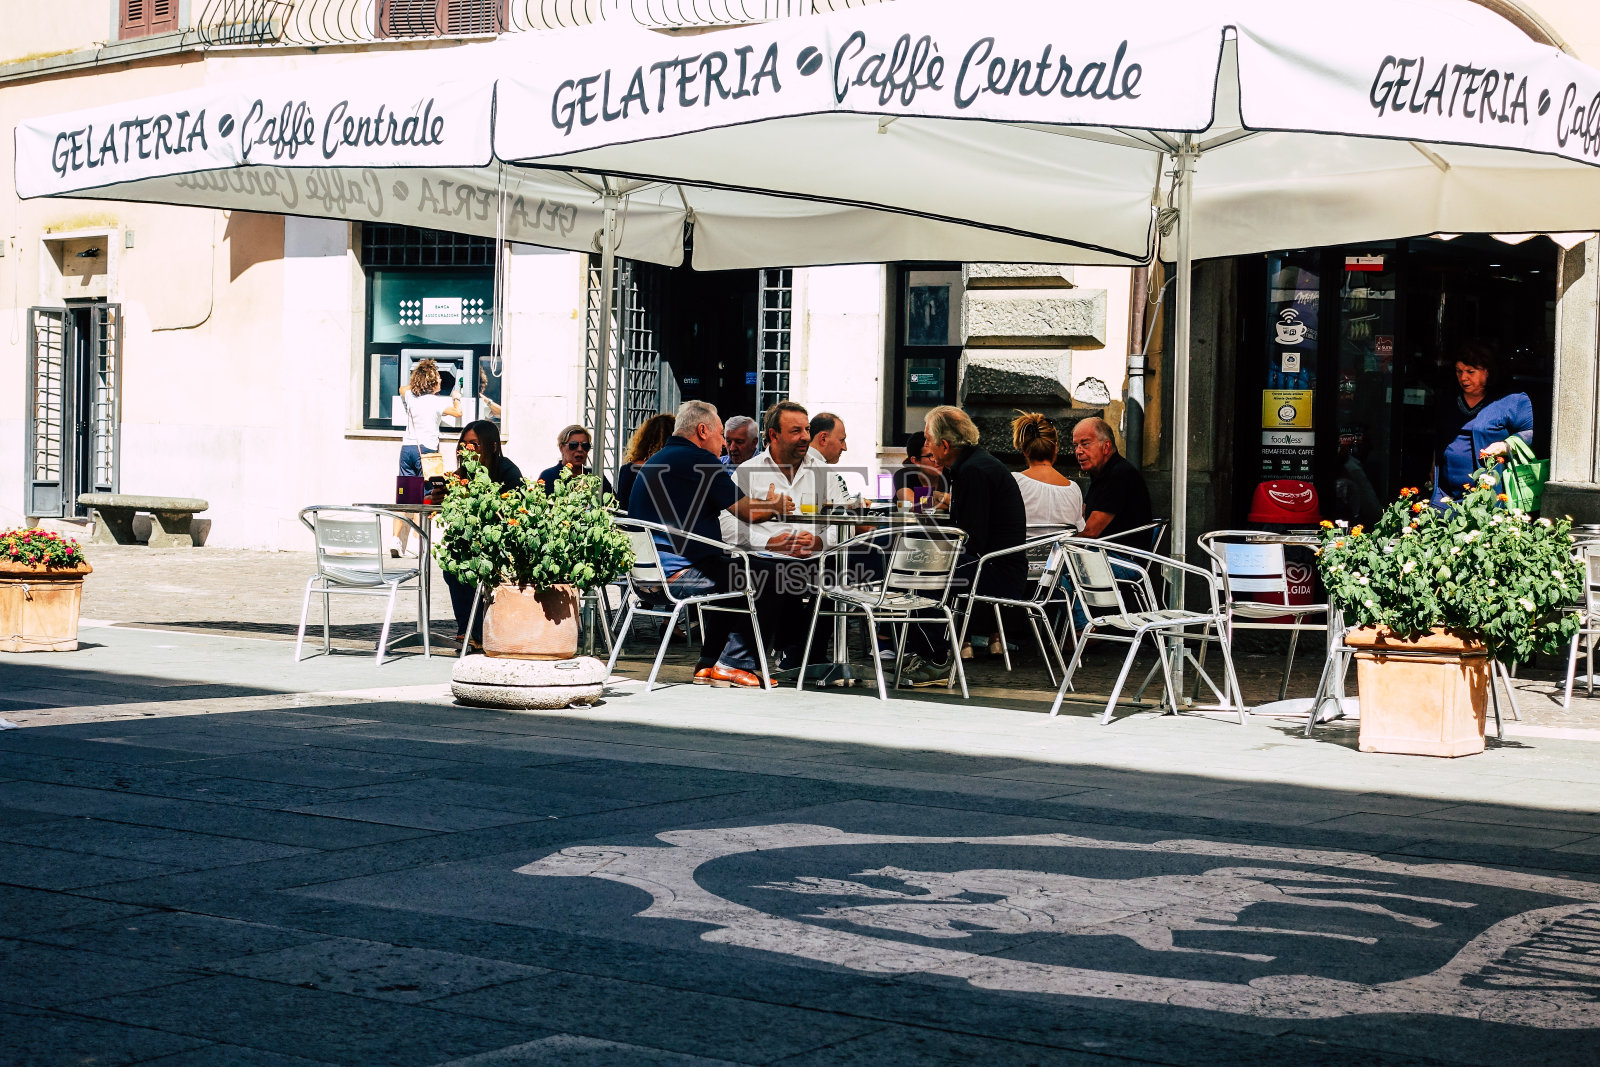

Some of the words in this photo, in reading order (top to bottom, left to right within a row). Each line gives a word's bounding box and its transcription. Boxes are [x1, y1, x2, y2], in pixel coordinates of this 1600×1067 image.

[552, 42, 782, 136] GELATERIA
[834, 31, 944, 107] Caffè
[954, 37, 1142, 109] Centrale
[1369, 55, 1529, 126] GELATERIA
[51, 109, 208, 178] GELATERIA
[241, 99, 316, 161] Caffè
[322, 97, 445, 160] Centrale
